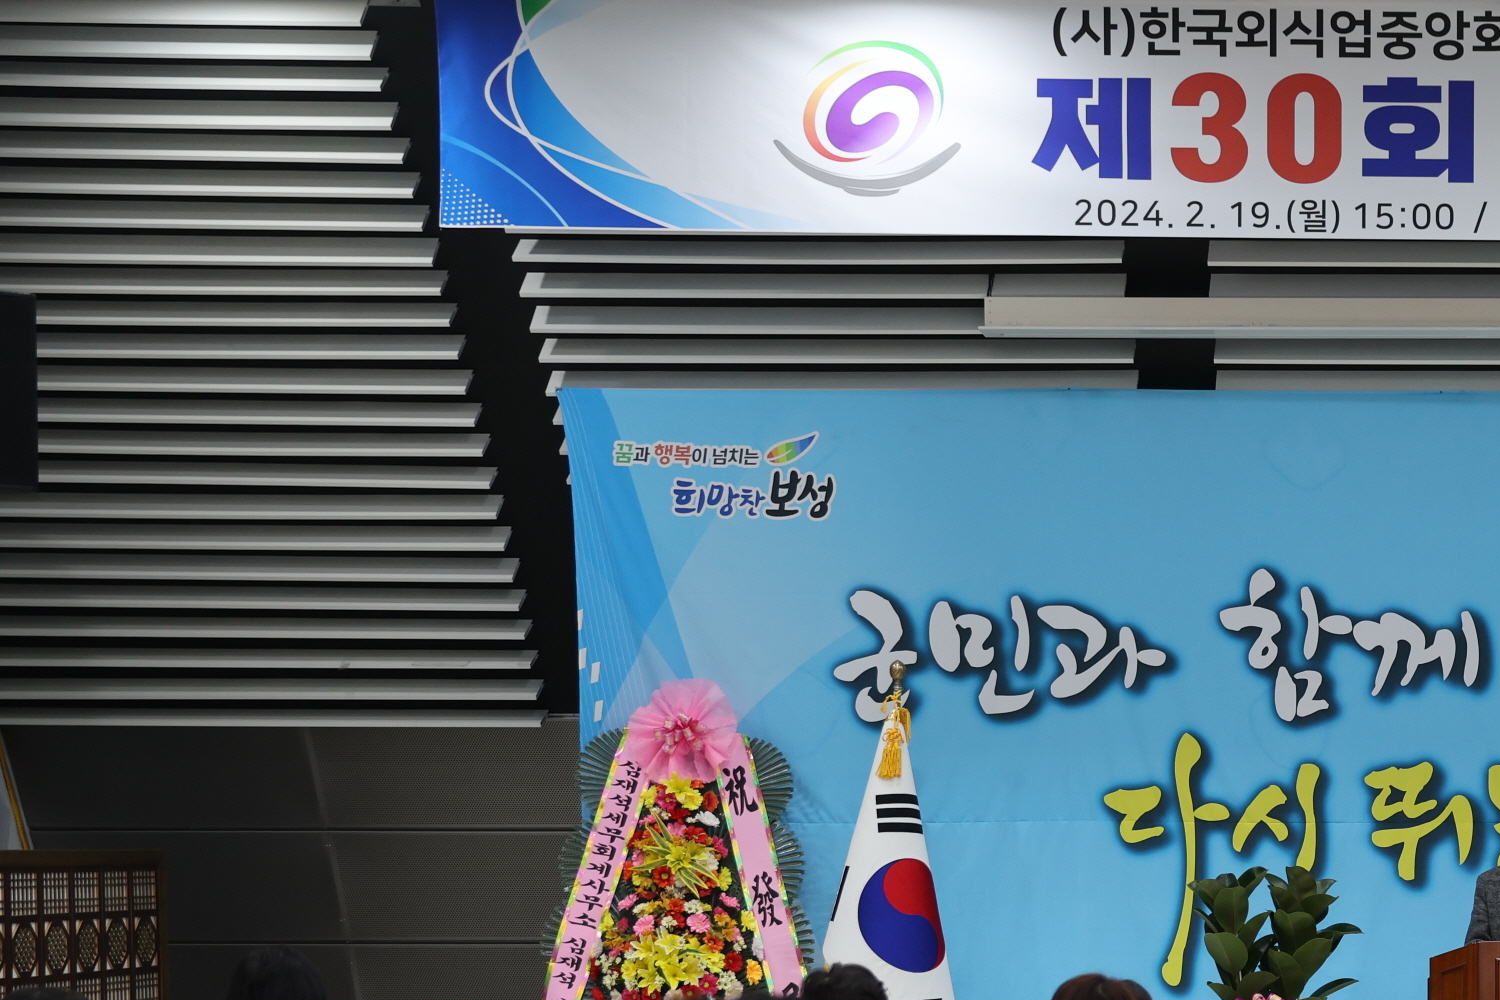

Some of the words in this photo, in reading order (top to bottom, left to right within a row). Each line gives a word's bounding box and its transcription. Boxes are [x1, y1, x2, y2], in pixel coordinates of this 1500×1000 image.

[1031, 72, 1475, 185] 제30회
[1354, 202, 1455, 230] 15:00
[615, 443, 650, 464] 꿈과
[654, 443, 708, 466] 행복이
[712, 447, 760, 466] 넘치는
[765, 470, 834, 519] 보성
[833, 589, 1167, 723] 군민과
[1219, 568, 1480, 722] 함께
[1103, 732, 1320, 988] 다시
[551, 936, 588, 990] 심재석
